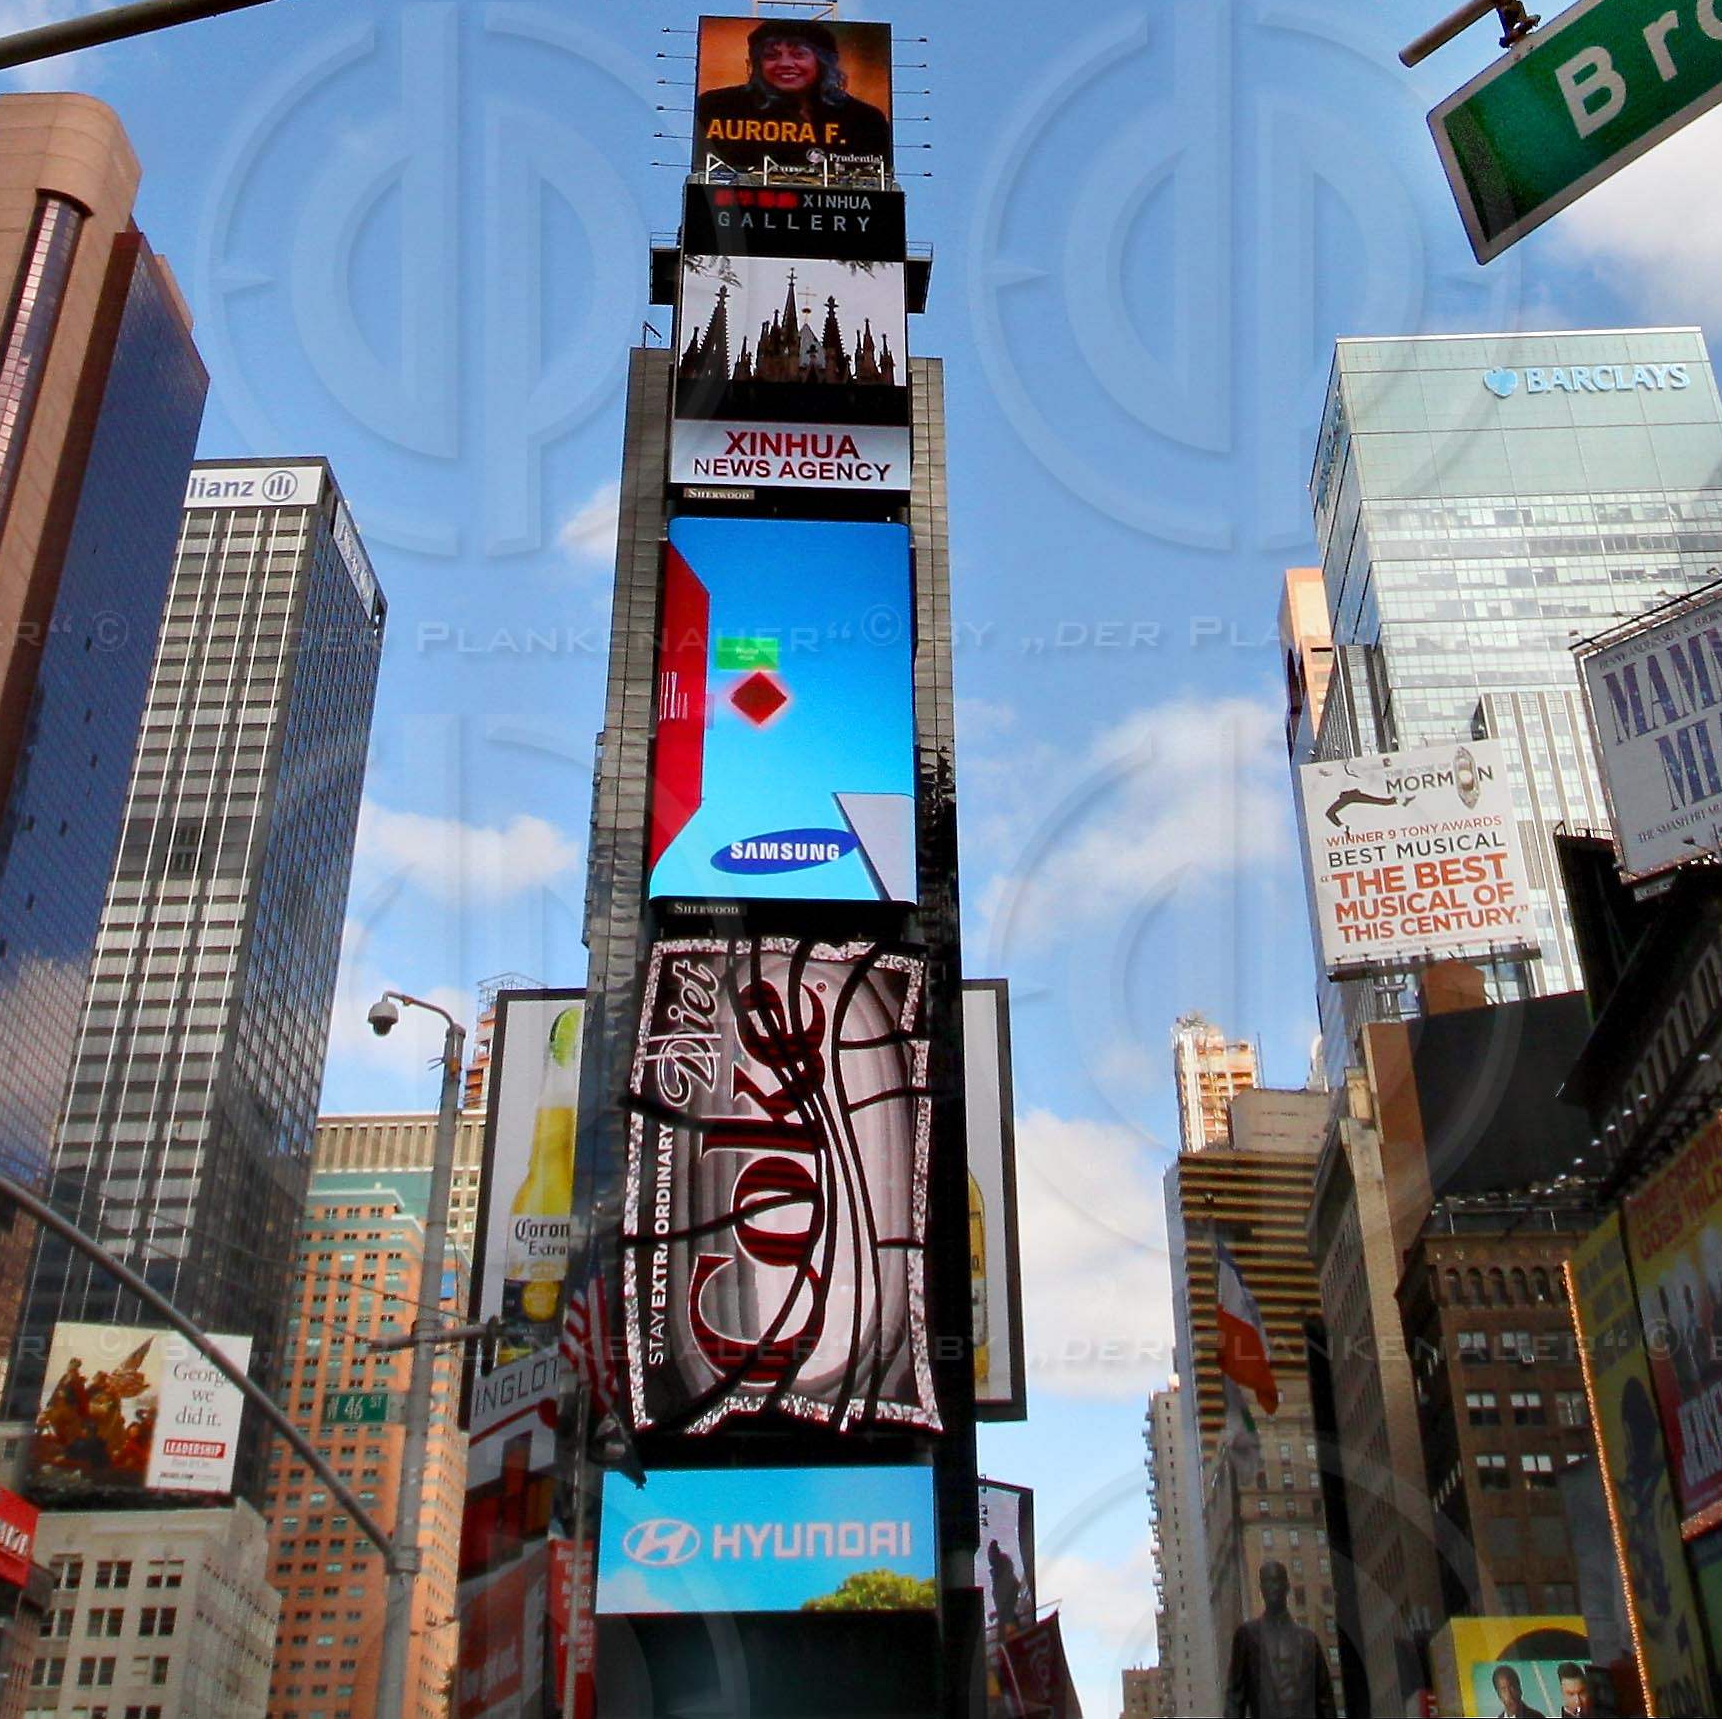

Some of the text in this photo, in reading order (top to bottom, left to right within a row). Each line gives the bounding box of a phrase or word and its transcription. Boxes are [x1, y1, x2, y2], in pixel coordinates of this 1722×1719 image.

[706, 119, 848, 144] AURORA F.
[829, 153, 885, 165] Prudential
[802, 193, 872, 211] XINHUA
[717, 211, 871, 233] GALLERY
[1524, 363, 1692, 395] BARCLAYS
[724, 430, 861, 460] XINHUA
[693, 457, 892, 482] NEWS AGENCY
[1326, 815, 1503, 847] WINNER 9 TONY AWARDS
[730, 841, 841, 862] SAMSUNG
[1328, 831, 1506, 868] BEST MUSICAL
[1413, 853, 1509, 890] BEST
[1334, 882, 1515, 923] MUSICAL OF
[1338, 923, 1395, 944] THIS
[645, 959, 722, 1108] Diet
[687, 981, 827, 1388] Coke
[528, 1241, 567, 1256] Extra
[192, 1391, 214, 1403] we
[343, 1398, 363, 1420] 46
[175, 1406, 222, 1427] did it.
[165, 1441, 223, 1457] LEADERSHIP
[712, 1520, 912, 1561] HYUNDAI
